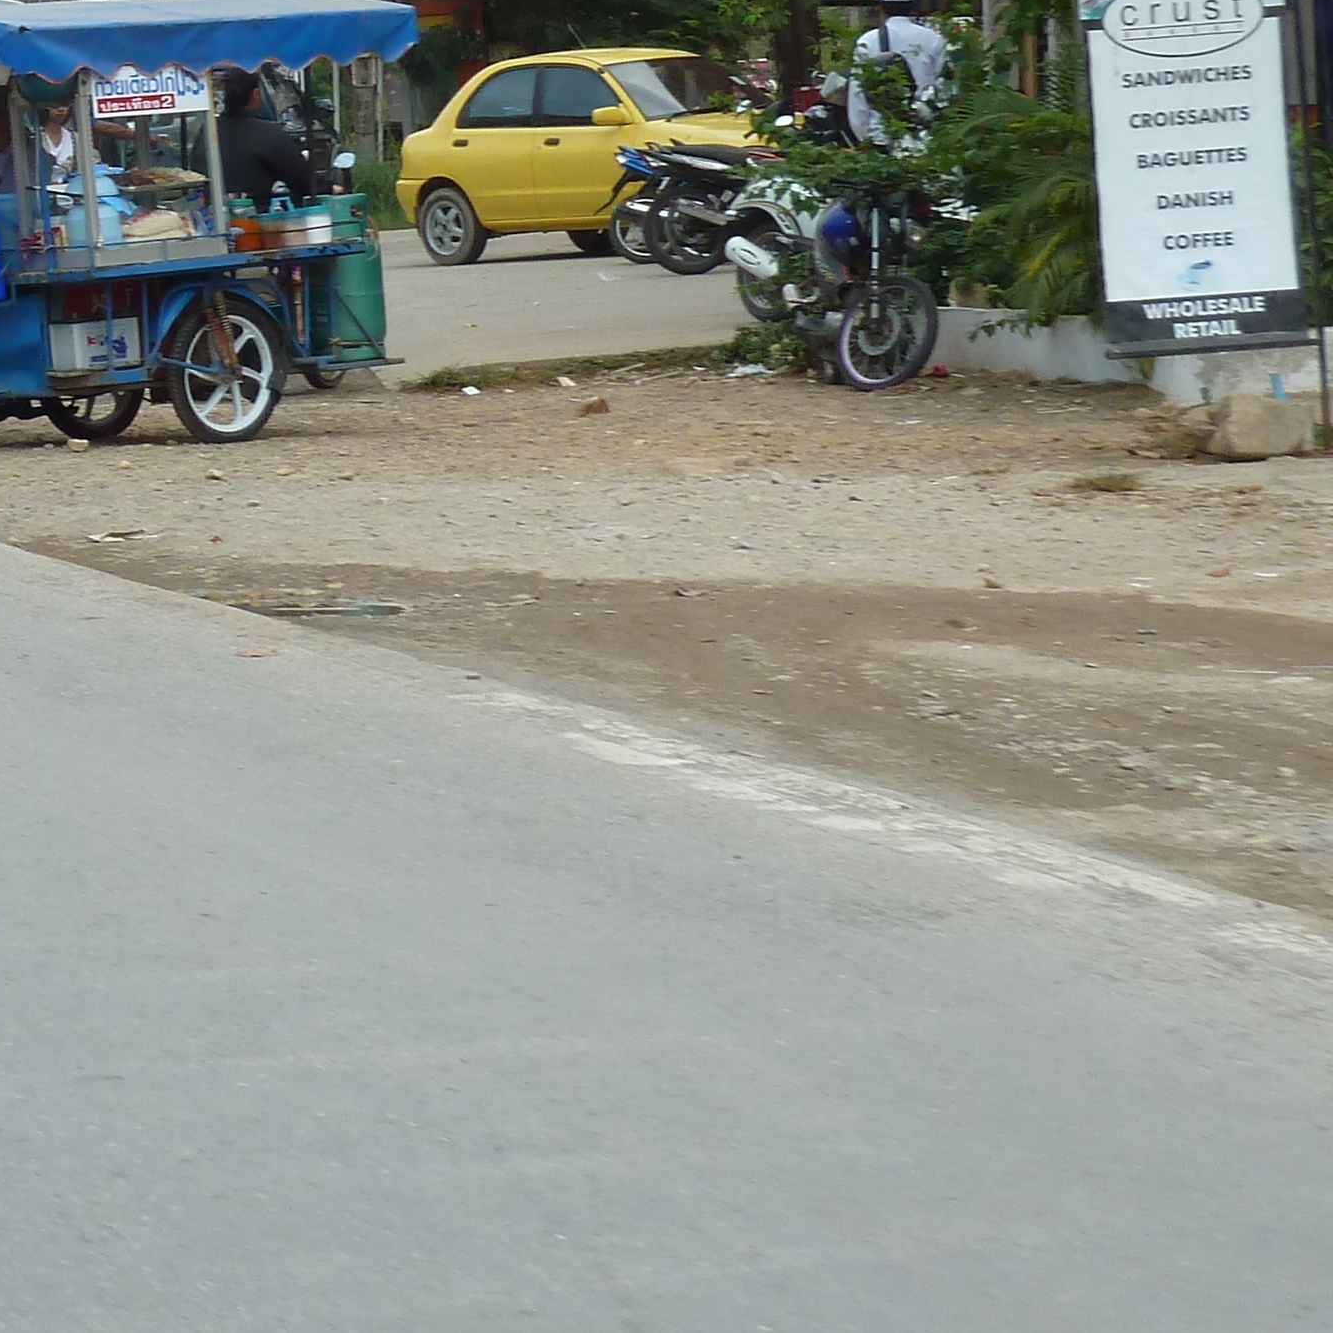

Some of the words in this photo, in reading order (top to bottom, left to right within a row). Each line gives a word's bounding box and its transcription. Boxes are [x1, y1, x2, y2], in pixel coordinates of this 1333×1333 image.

[1121, 64, 1253, 89] SANDWICHES
[1129, 105, 1251, 129] CROISSANTS
[1136, 146, 1248, 169] BAGUETTES
[1156, 190, 1234, 210] DANISH
[1163, 231, 1235, 251] COFFEE
[1141, 295, 1266, 319] WHOLESALE
[1172, 318, 1242, 339] RETAIL
